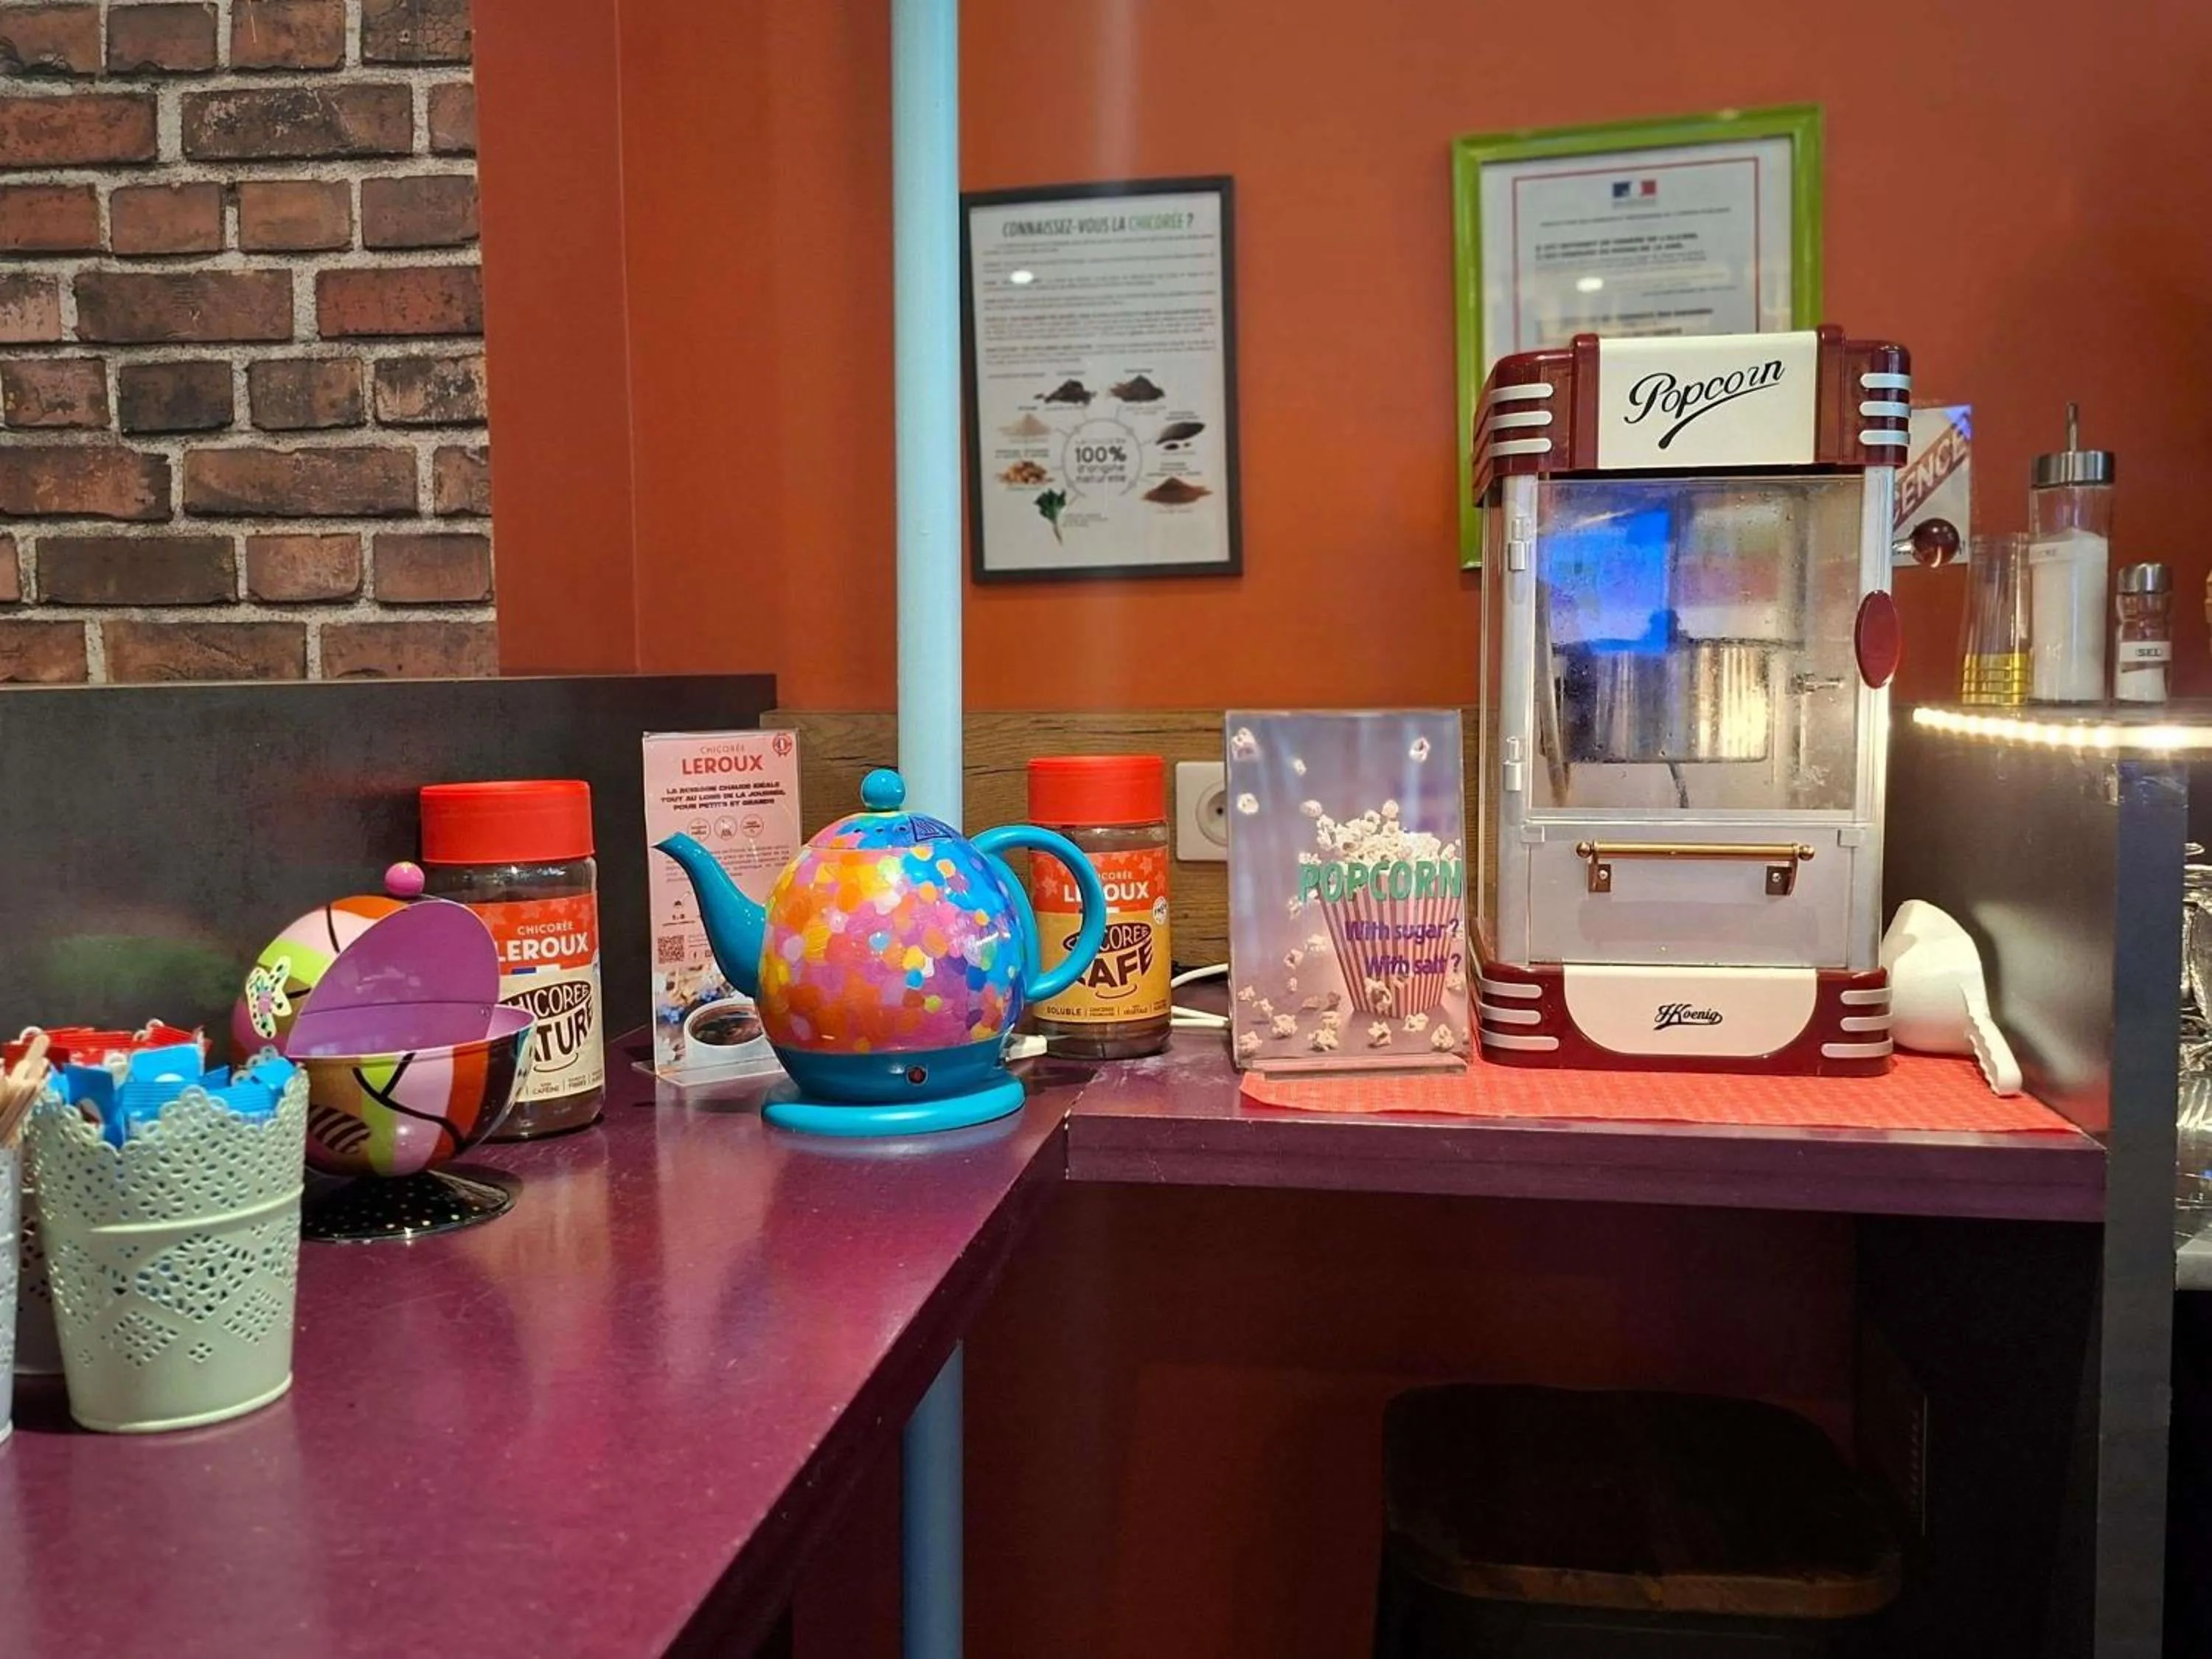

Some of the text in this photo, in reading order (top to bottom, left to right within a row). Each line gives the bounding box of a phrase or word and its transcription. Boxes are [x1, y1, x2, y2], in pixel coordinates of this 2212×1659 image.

[1112, 216, 1125, 232] LA
[1624, 359, 1785, 424] Popcorn
[1075, 446, 1127, 463] 100%
[682, 754, 763, 775] LEROUX
[1064, 881, 1150, 902] LOUX
[1298, 860, 1462, 903] POPCORN
[518, 920, 573, 936] CHICORÉE
[1346, 919, 1459, 945] With sugar ?
[1366, 953, 1461, 977] With salt ?
[1046, 1006, 1082, 1015] SOLUBLE
